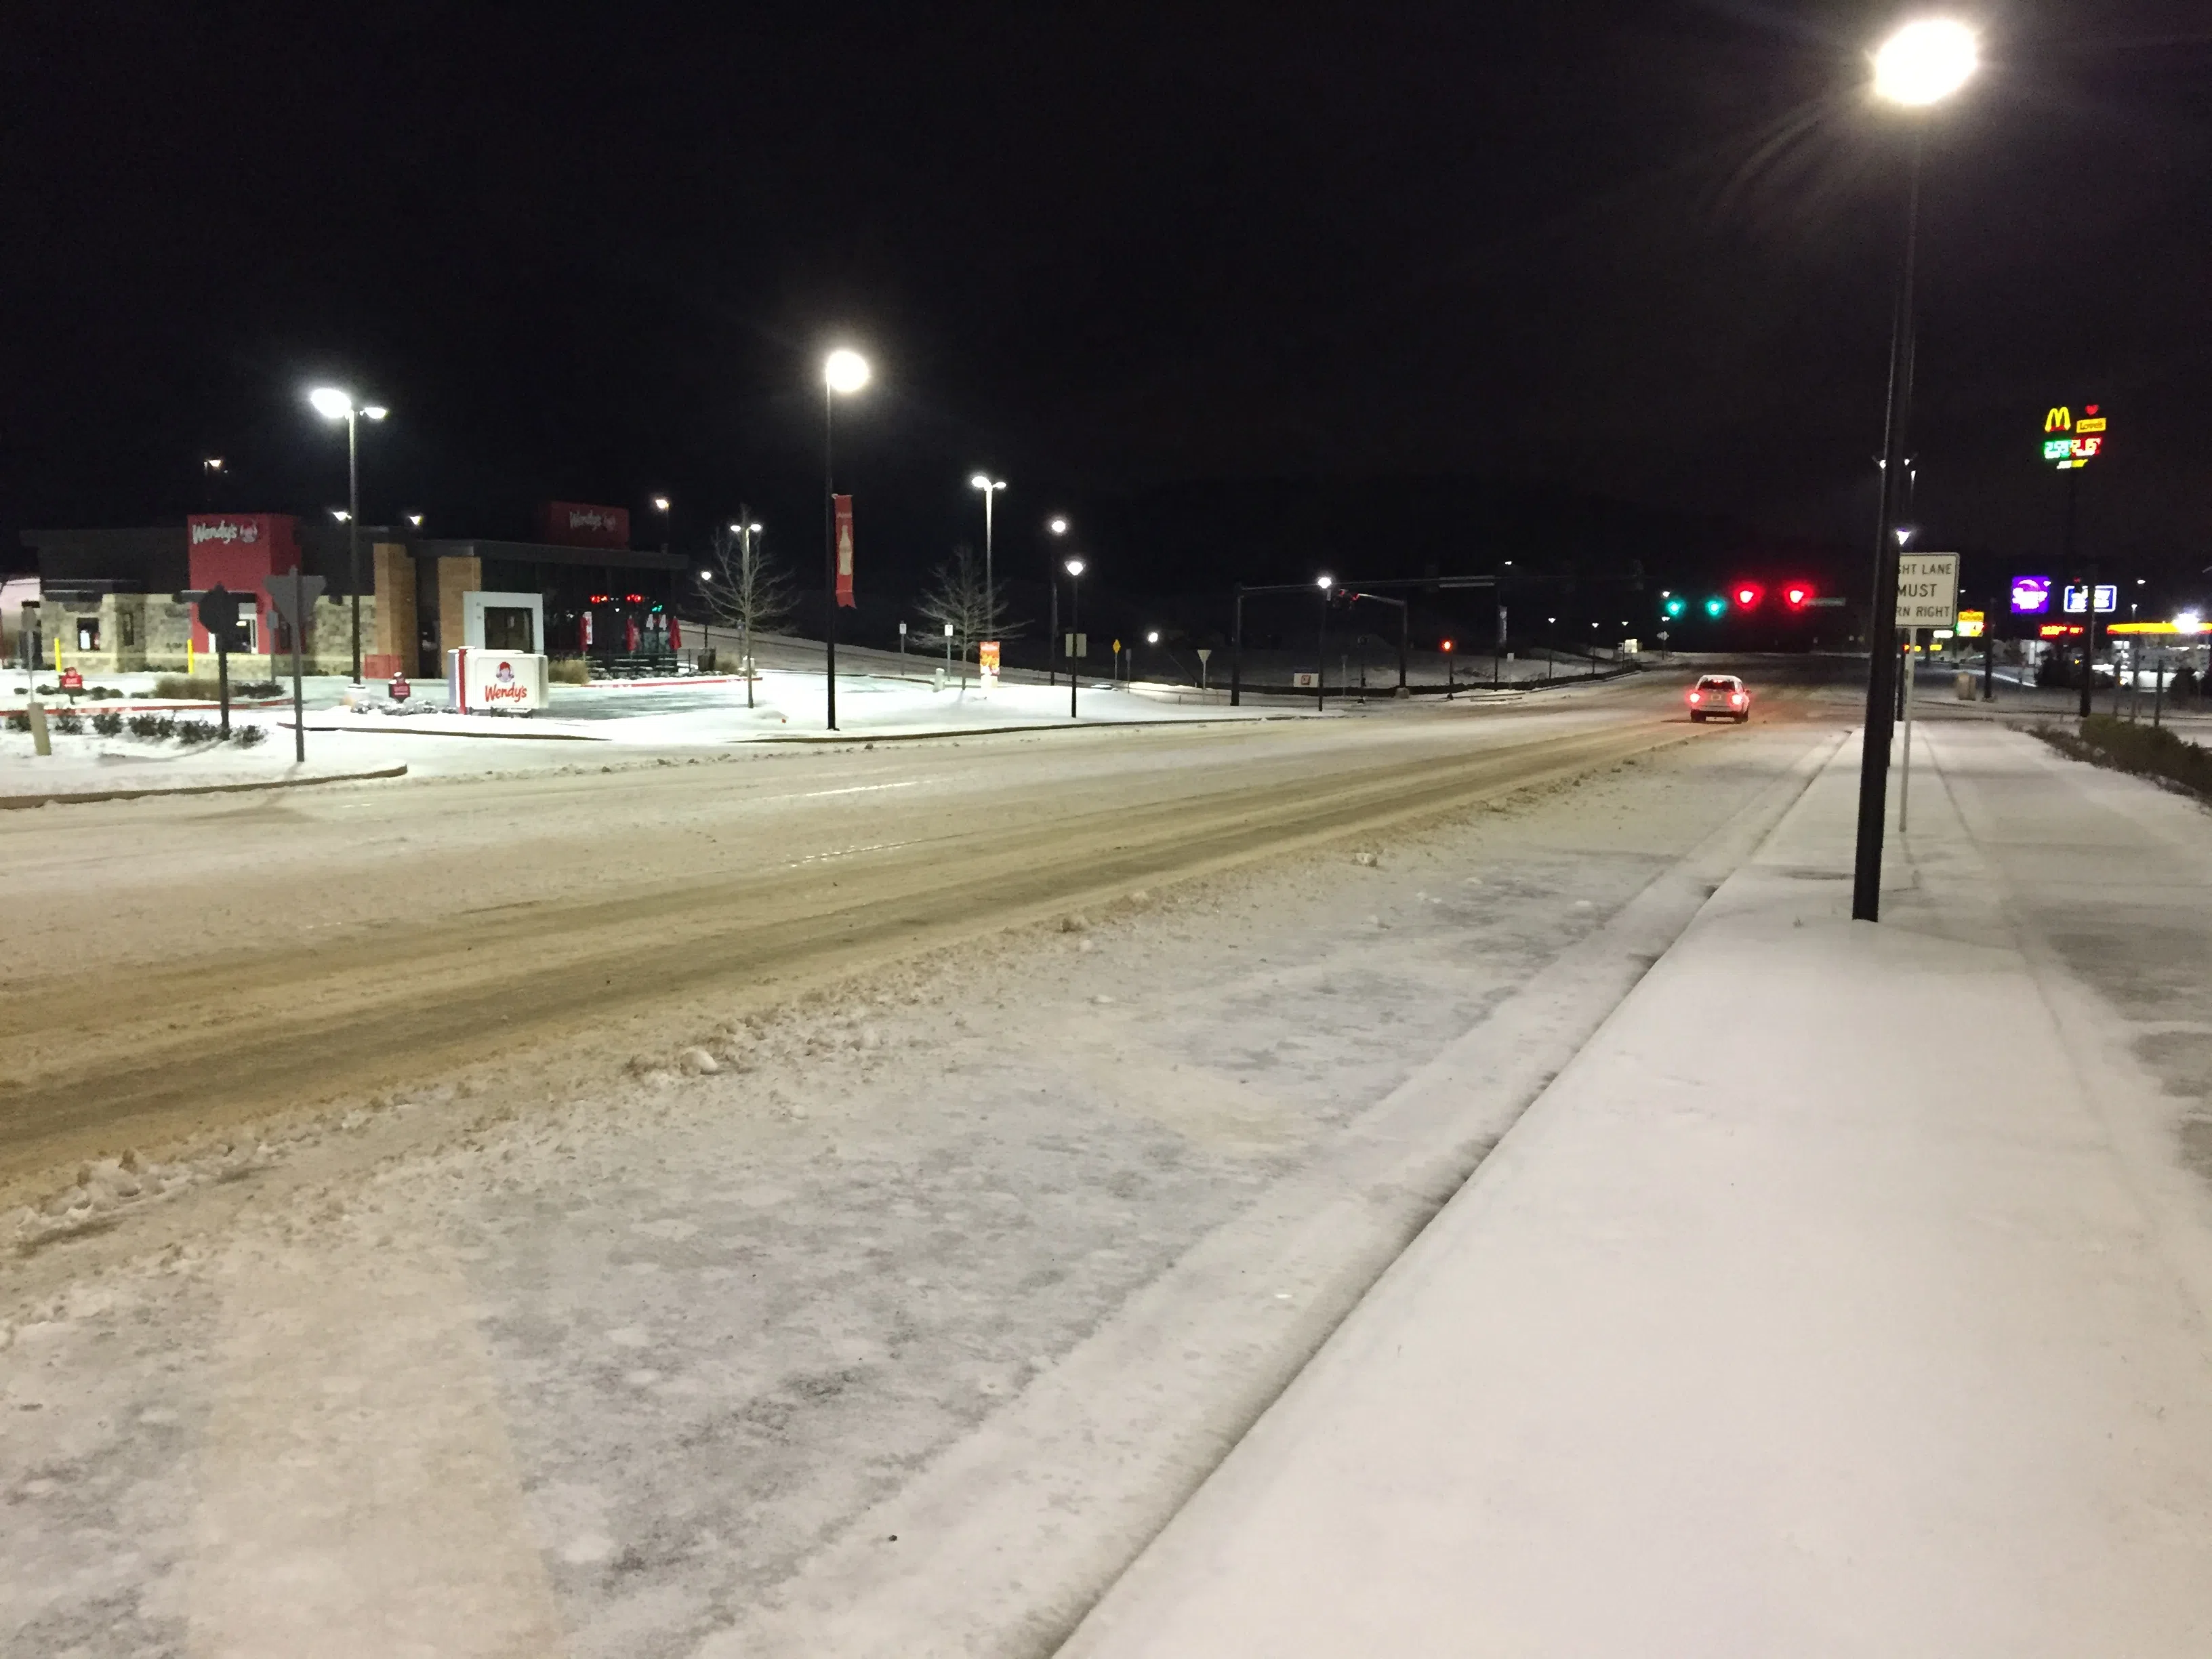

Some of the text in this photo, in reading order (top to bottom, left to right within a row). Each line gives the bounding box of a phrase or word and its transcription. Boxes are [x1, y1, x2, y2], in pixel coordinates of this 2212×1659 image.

[192, 520, 237, 545] Wendy's
[1922, 563, 1952, 575] LANE
[1897, 606, 1950, 617] RN RIGHT
[485, 682, 527, 703] Wendy's
